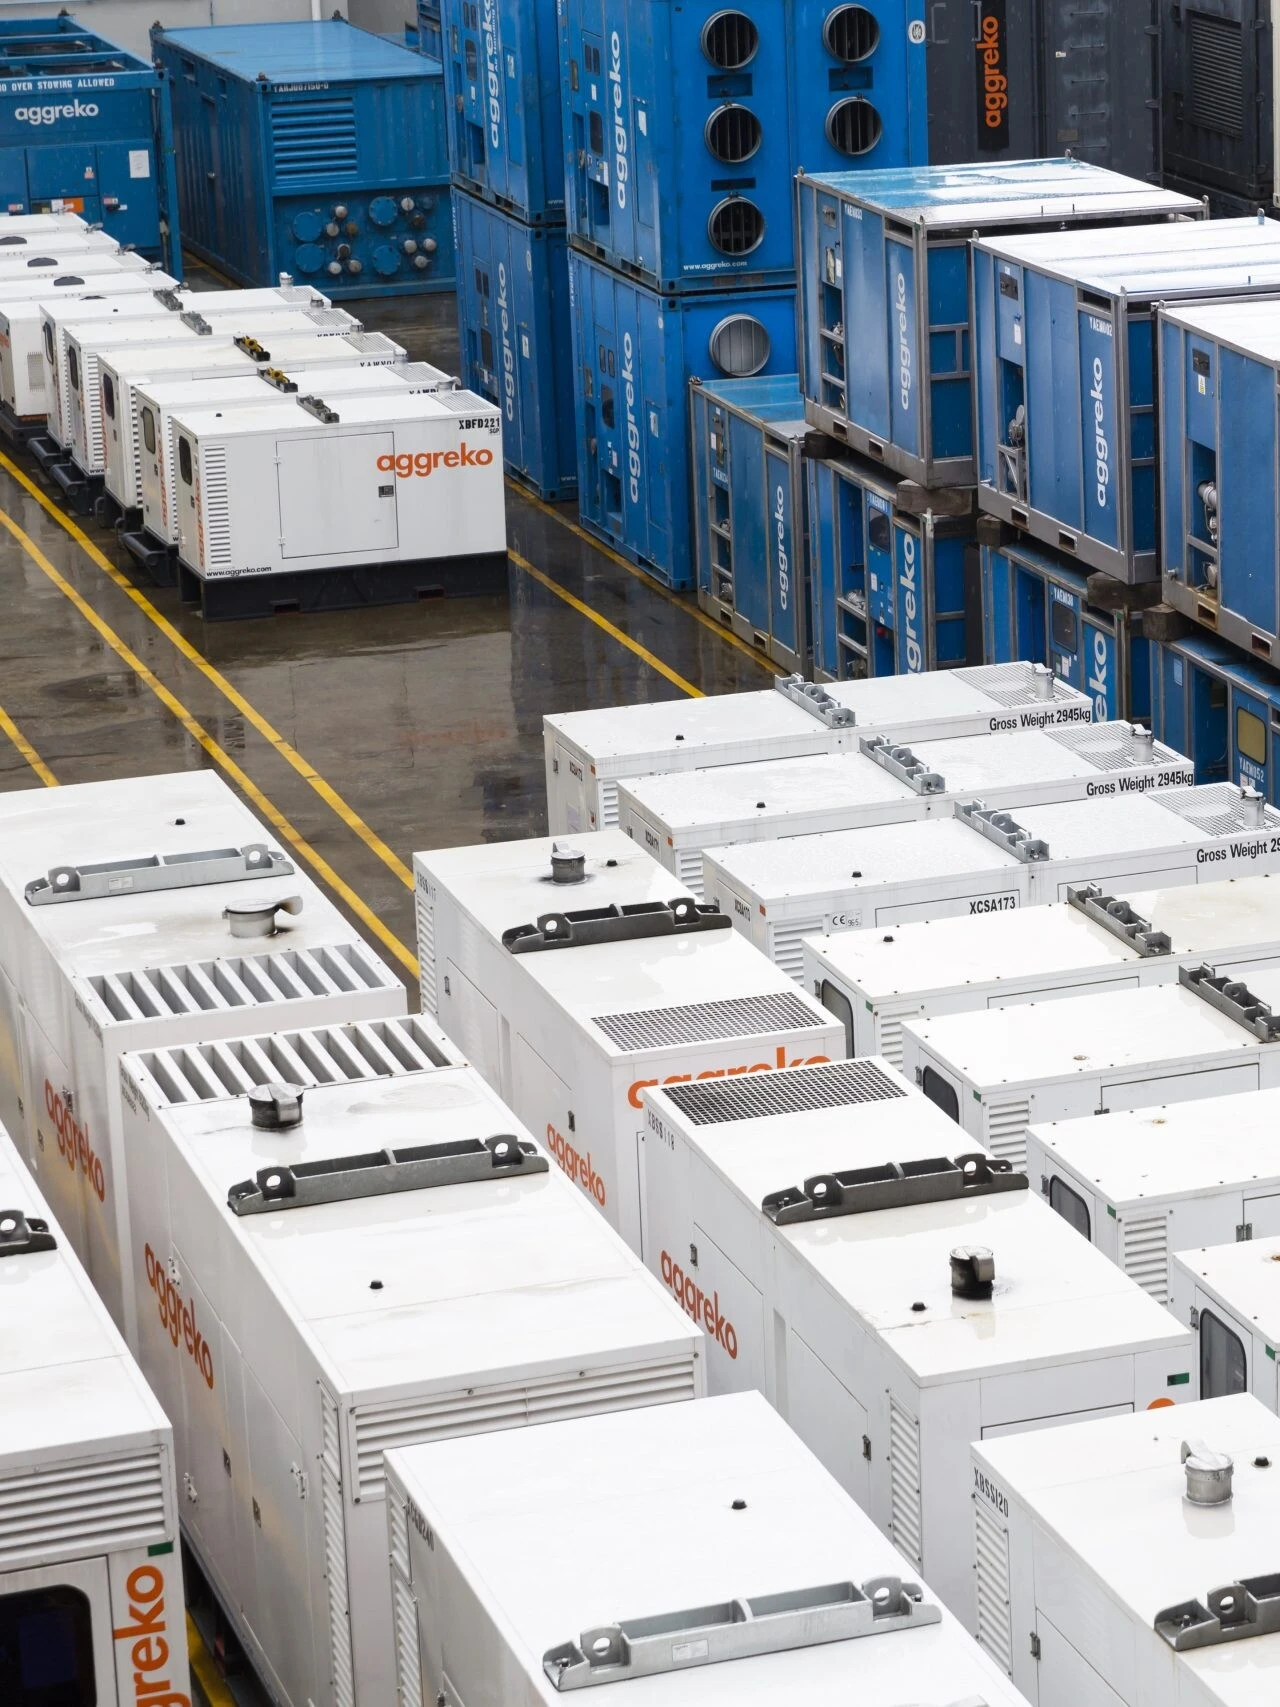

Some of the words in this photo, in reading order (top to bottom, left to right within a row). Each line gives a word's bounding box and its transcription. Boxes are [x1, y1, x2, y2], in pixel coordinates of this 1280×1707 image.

[0, 84, 7, 92] O
[12, 82, 33, 92] OVER
[38, 80, 72, 90] STOWING
[78, 78, 115, 88] ALLOWED
[15, 99, 99, 125] aggreko
[610, 31, 628, 209] aggreko
[976, 16, 1008, 128] aggreko
[683, 260, 748, 271] www.aggreko.com
[498, 262, 515, 421] aggreko
[896, 272, 911, 410] aggreko
[376, 442, 494, 479] aggreko
[459, 418, 500, 430] XBFD221
[622, 332, 641, 504] aggreko
[1091, 357, 1108, 507] aggreko
[206, 566, 272, 578] www.aggreko.com
[775, 485, 788, 610] aggreko
[900, 533, 922, 674] greko
[989, 718, 1017, 731] Gross
[1020, 710, 1055, 728] Weight
[1057, 707, 1091, 723] 2945kg
[1086, 782, 1116, 797] Gross
[1119, 773, 1155, 793] Weight
[1157, 769, 1193, 789] 2945kg
[969, 896, 1016, 915] XCSA173
[1196, 848, 1226, 864] Gross
[1230, 840, 1268, 860] Weight
[45, 1078, 105, 1202] aggreko
[547, 1123, 606, 1207] aggreko
[144, 1242, 214, 1389] aggreko
[661, 1250, 737, 1360] aggreko
[113, 1564, 192, 1707] reko
